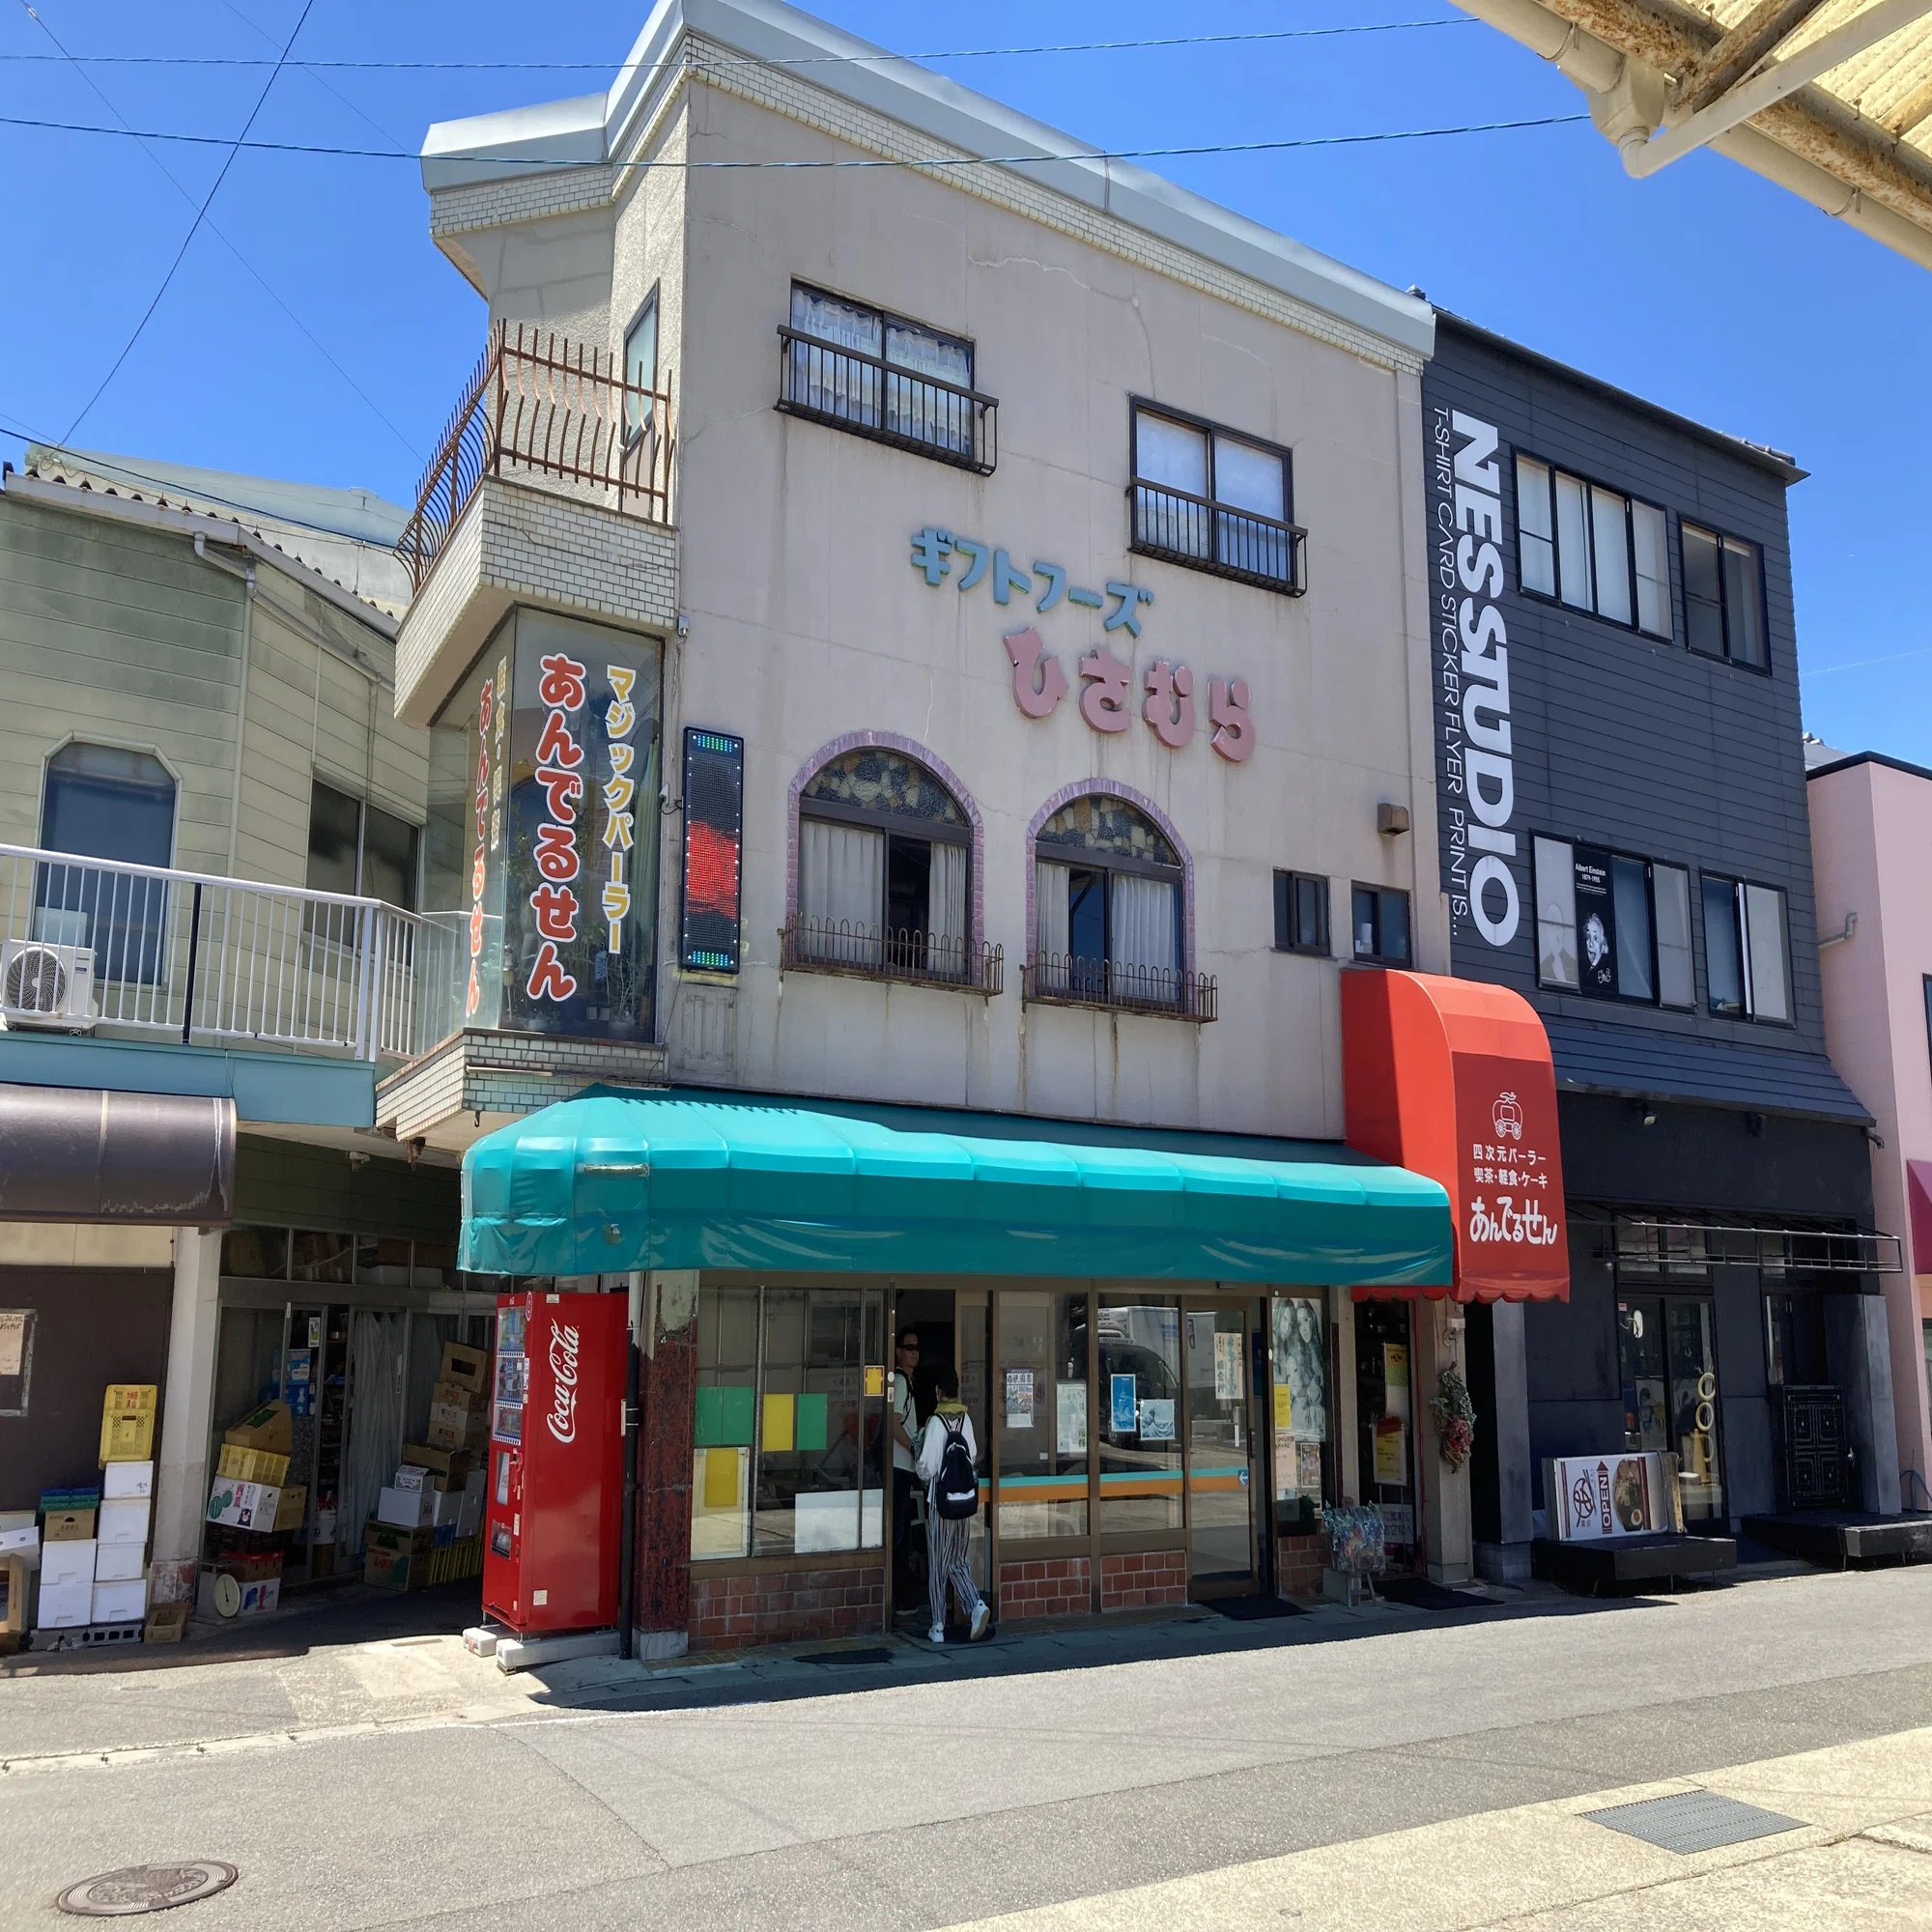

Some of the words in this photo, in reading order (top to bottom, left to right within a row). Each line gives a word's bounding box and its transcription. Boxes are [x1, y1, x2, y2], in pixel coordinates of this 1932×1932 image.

[1434, 408, 1452, 498] T-SHIRT
[911, 527, 1155, 639] ギフトフーズ
[1437, 501, 1456, 589] CARD
[1003, 626, 1256, 763] ひさむら
[1440, 594, 1460, 706] STICKER
[1444, 710, 1463, 794] FLYER
[466, 678, 494, 1018] あんでるせん
[526, 653, 586, 1002] あんでるせん
[602, 665, 636, 954] マジックパーラー
[1448, 807, 1466, 890] PRINT
[1576, 863, 1588, 872] Albert
[1589, 866, 1605, 876] Einstein
[1472, 1144, 1547, 1166] 四次元パーラー
[1469, 1196, 1558, 1245] あんでるせん
[547, 1318, 580, 1443] Coca-Cola
[1599, 1476, 1611, 1526] OPEN
